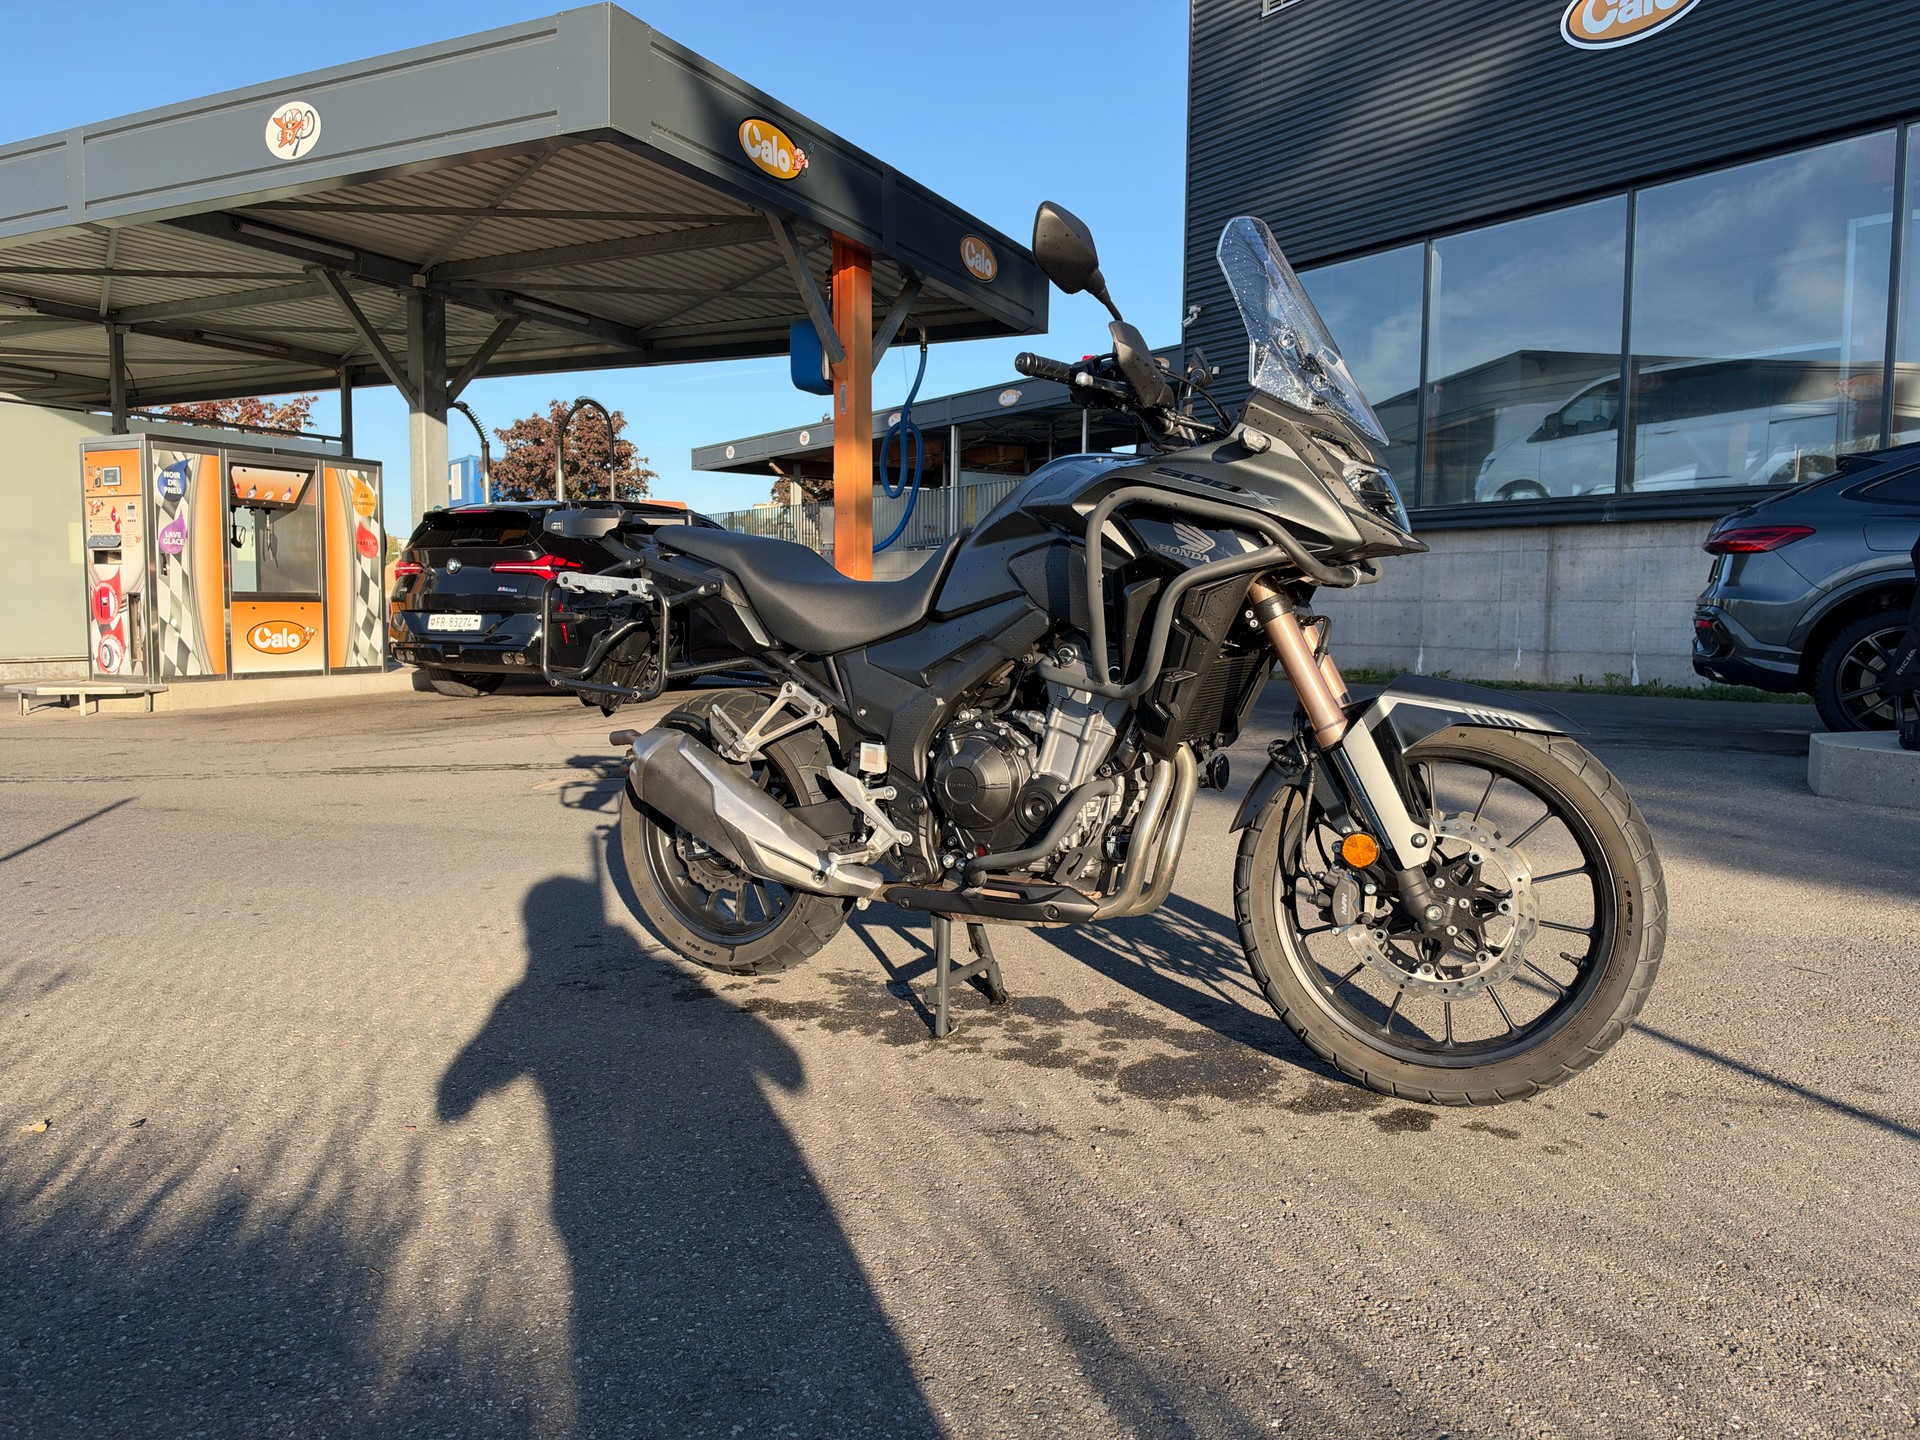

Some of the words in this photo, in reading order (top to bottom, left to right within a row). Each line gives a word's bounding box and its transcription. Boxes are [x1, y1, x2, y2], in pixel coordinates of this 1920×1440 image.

[1582, 0, 1678, 34] Ca
[743, 122, 790, 173] Calo
[965, 240, 992, 277] Calo
[163, 470, 181, 479] NOIR
[163, 486, 182, 495] PNEU
[167, 479, 178, 487] DE
[162, 538, 185, 546] GLACE
[165, 531, 182, 539] LAVE
[1157, 543, 1212, 564] HONDA
[254, 626, 301, 649] Calo
